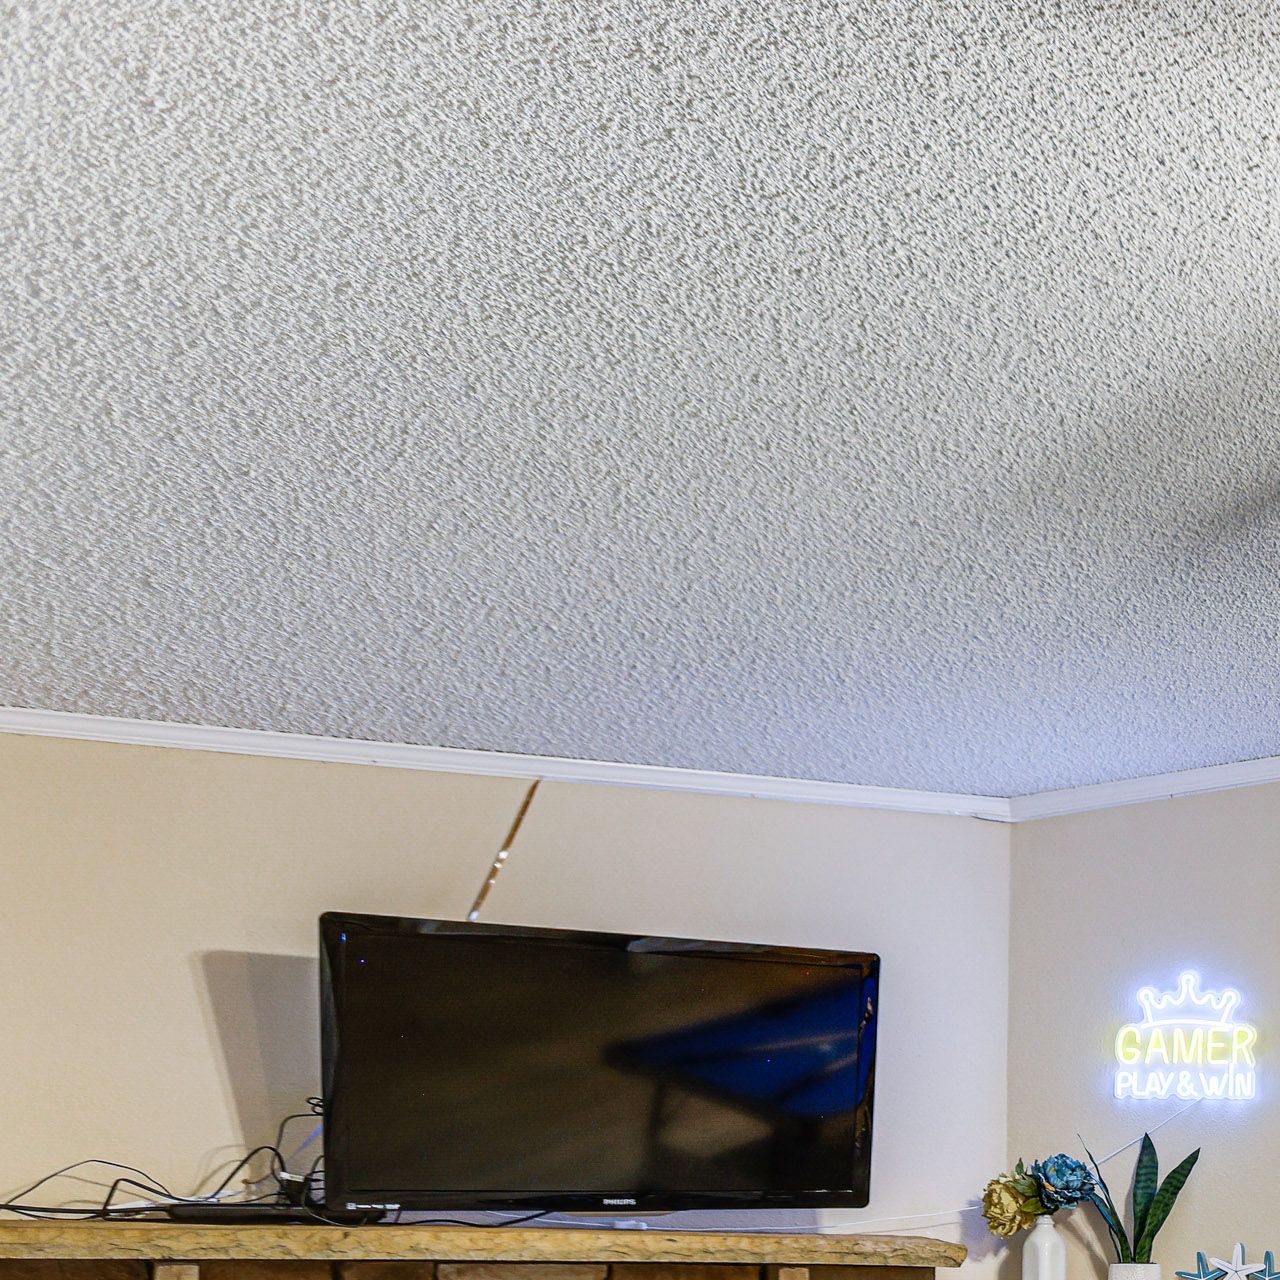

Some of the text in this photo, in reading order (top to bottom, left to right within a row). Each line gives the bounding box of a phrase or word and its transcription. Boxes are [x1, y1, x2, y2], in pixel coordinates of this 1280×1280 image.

[1116, 1026, 1256, 1065] GAMER
[1116, 1070, 1175, 1098] PLAY
[1177, 1070, 1198, 1097] &
